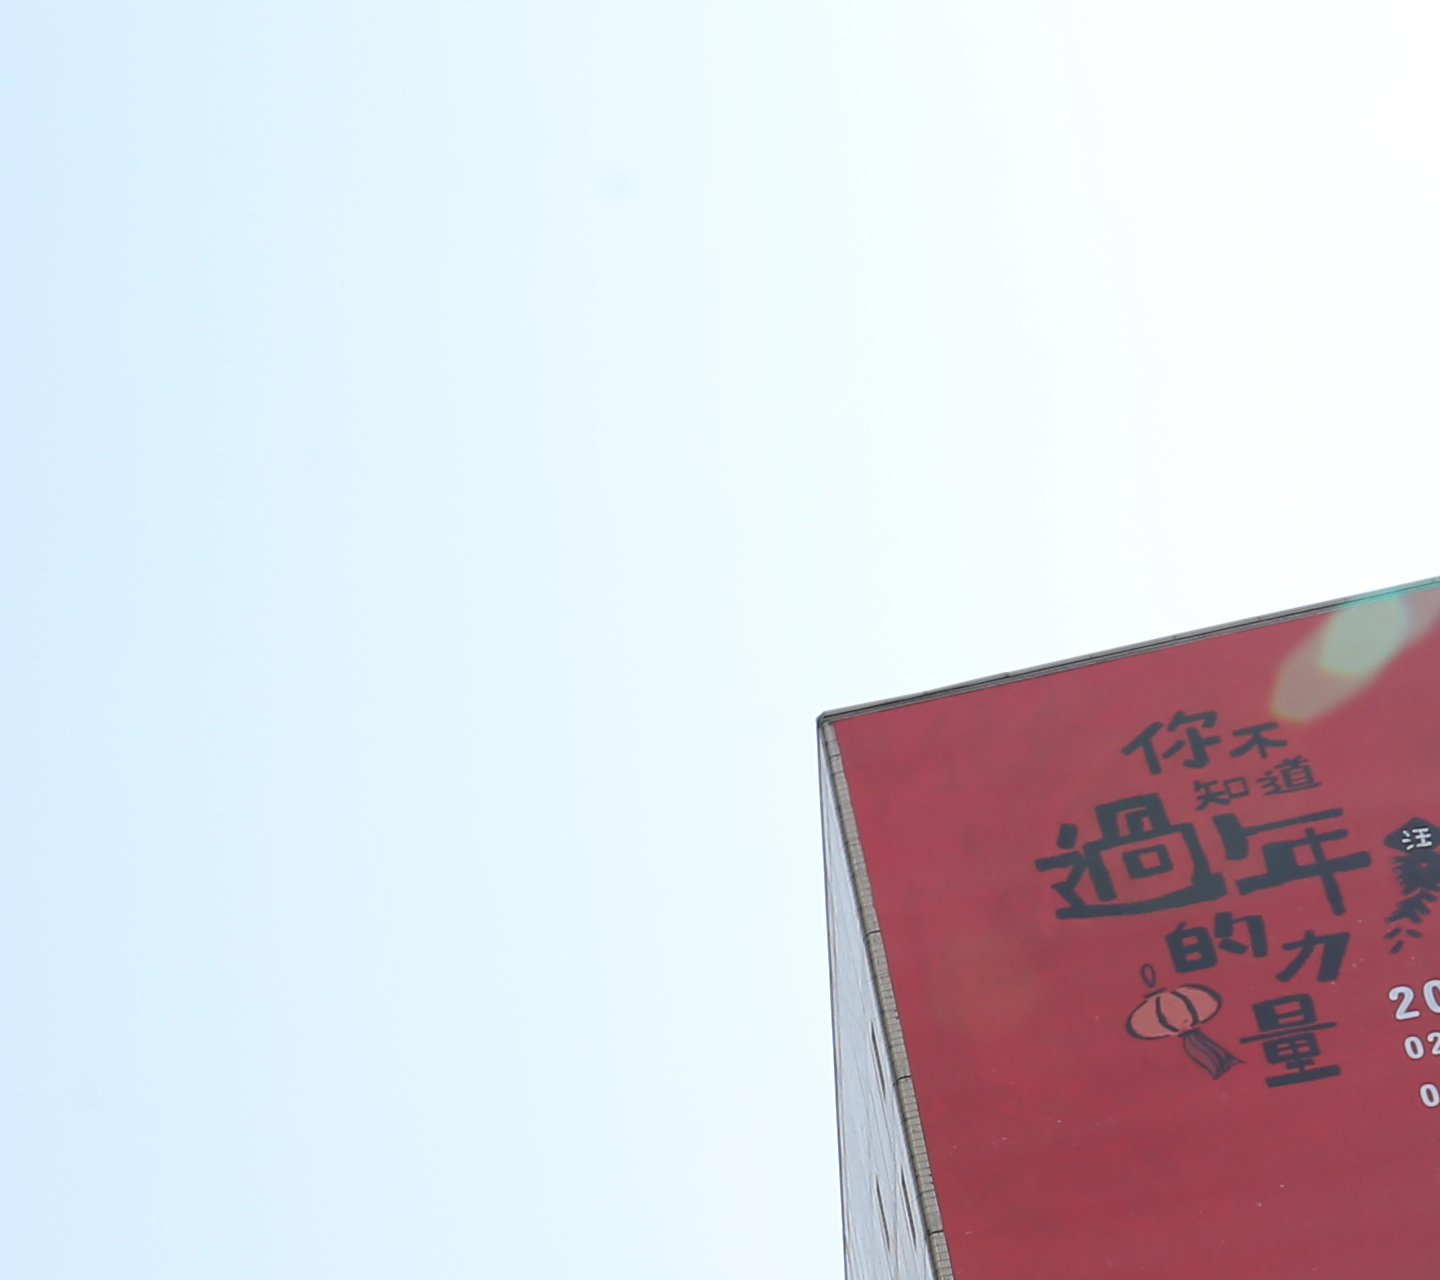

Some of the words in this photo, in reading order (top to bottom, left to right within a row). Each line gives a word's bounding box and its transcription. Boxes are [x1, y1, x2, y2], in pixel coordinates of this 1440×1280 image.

[1035, 793, 1372, 919] 過年
[1165, 911, 1351, 983] 的力
[1239, 992, 1342, 1088] 量
